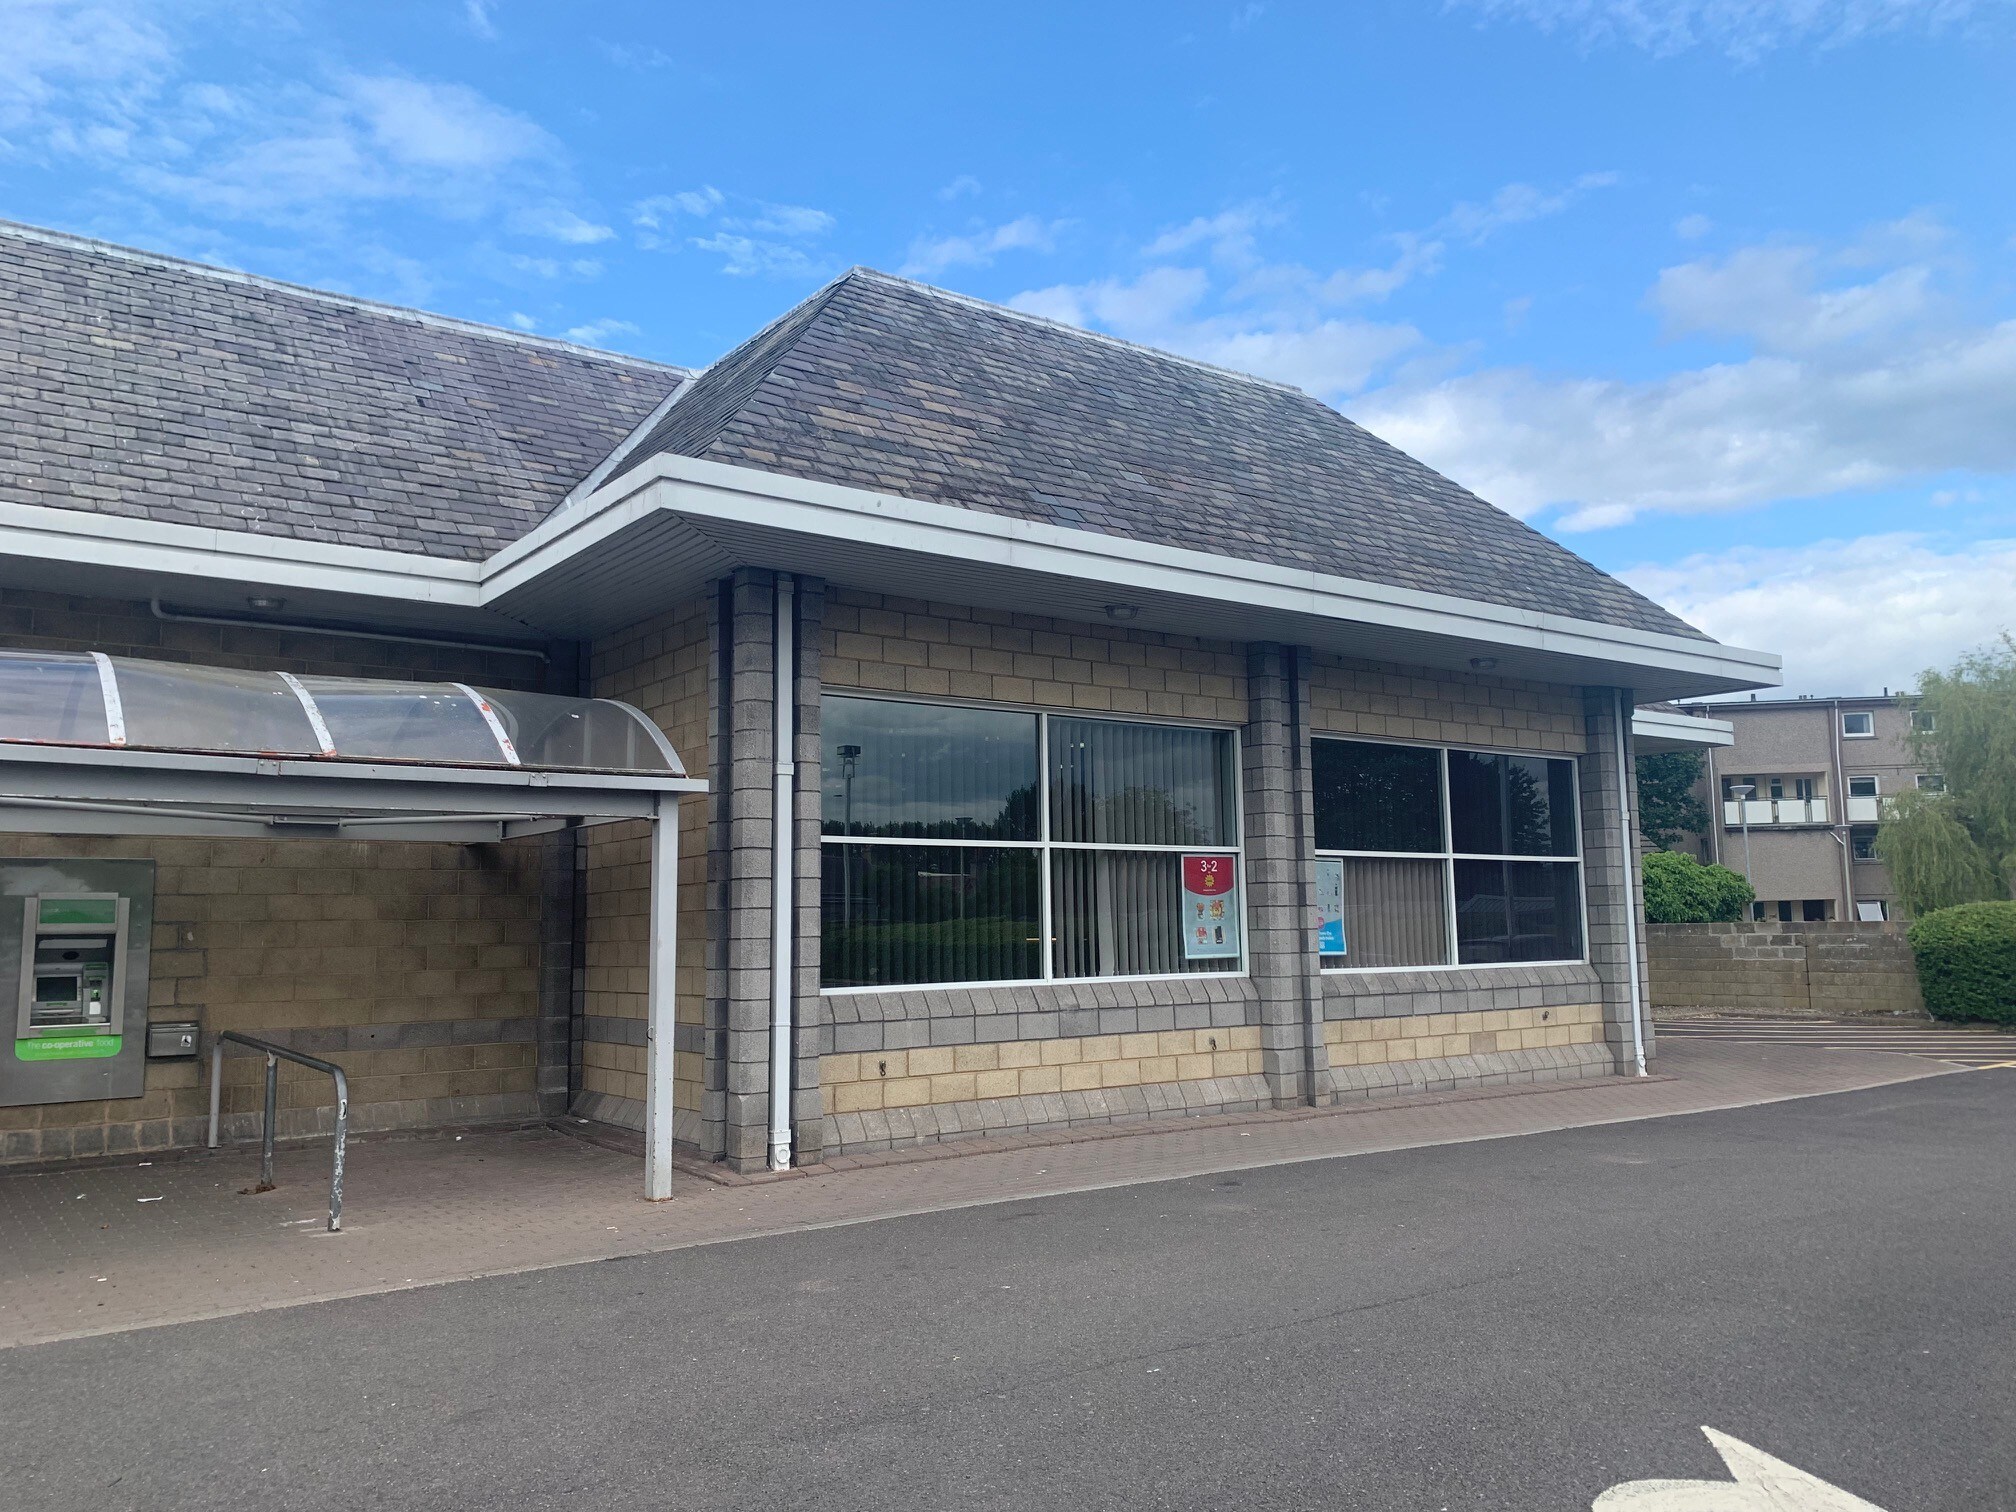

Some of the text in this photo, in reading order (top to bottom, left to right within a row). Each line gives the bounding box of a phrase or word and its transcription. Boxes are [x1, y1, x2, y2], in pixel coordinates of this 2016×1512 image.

[1200, 860, 1208, 872] 3
[1211, 860, 1218, 872] 2
[27, 1038, 114, 1050] The co-operative food
